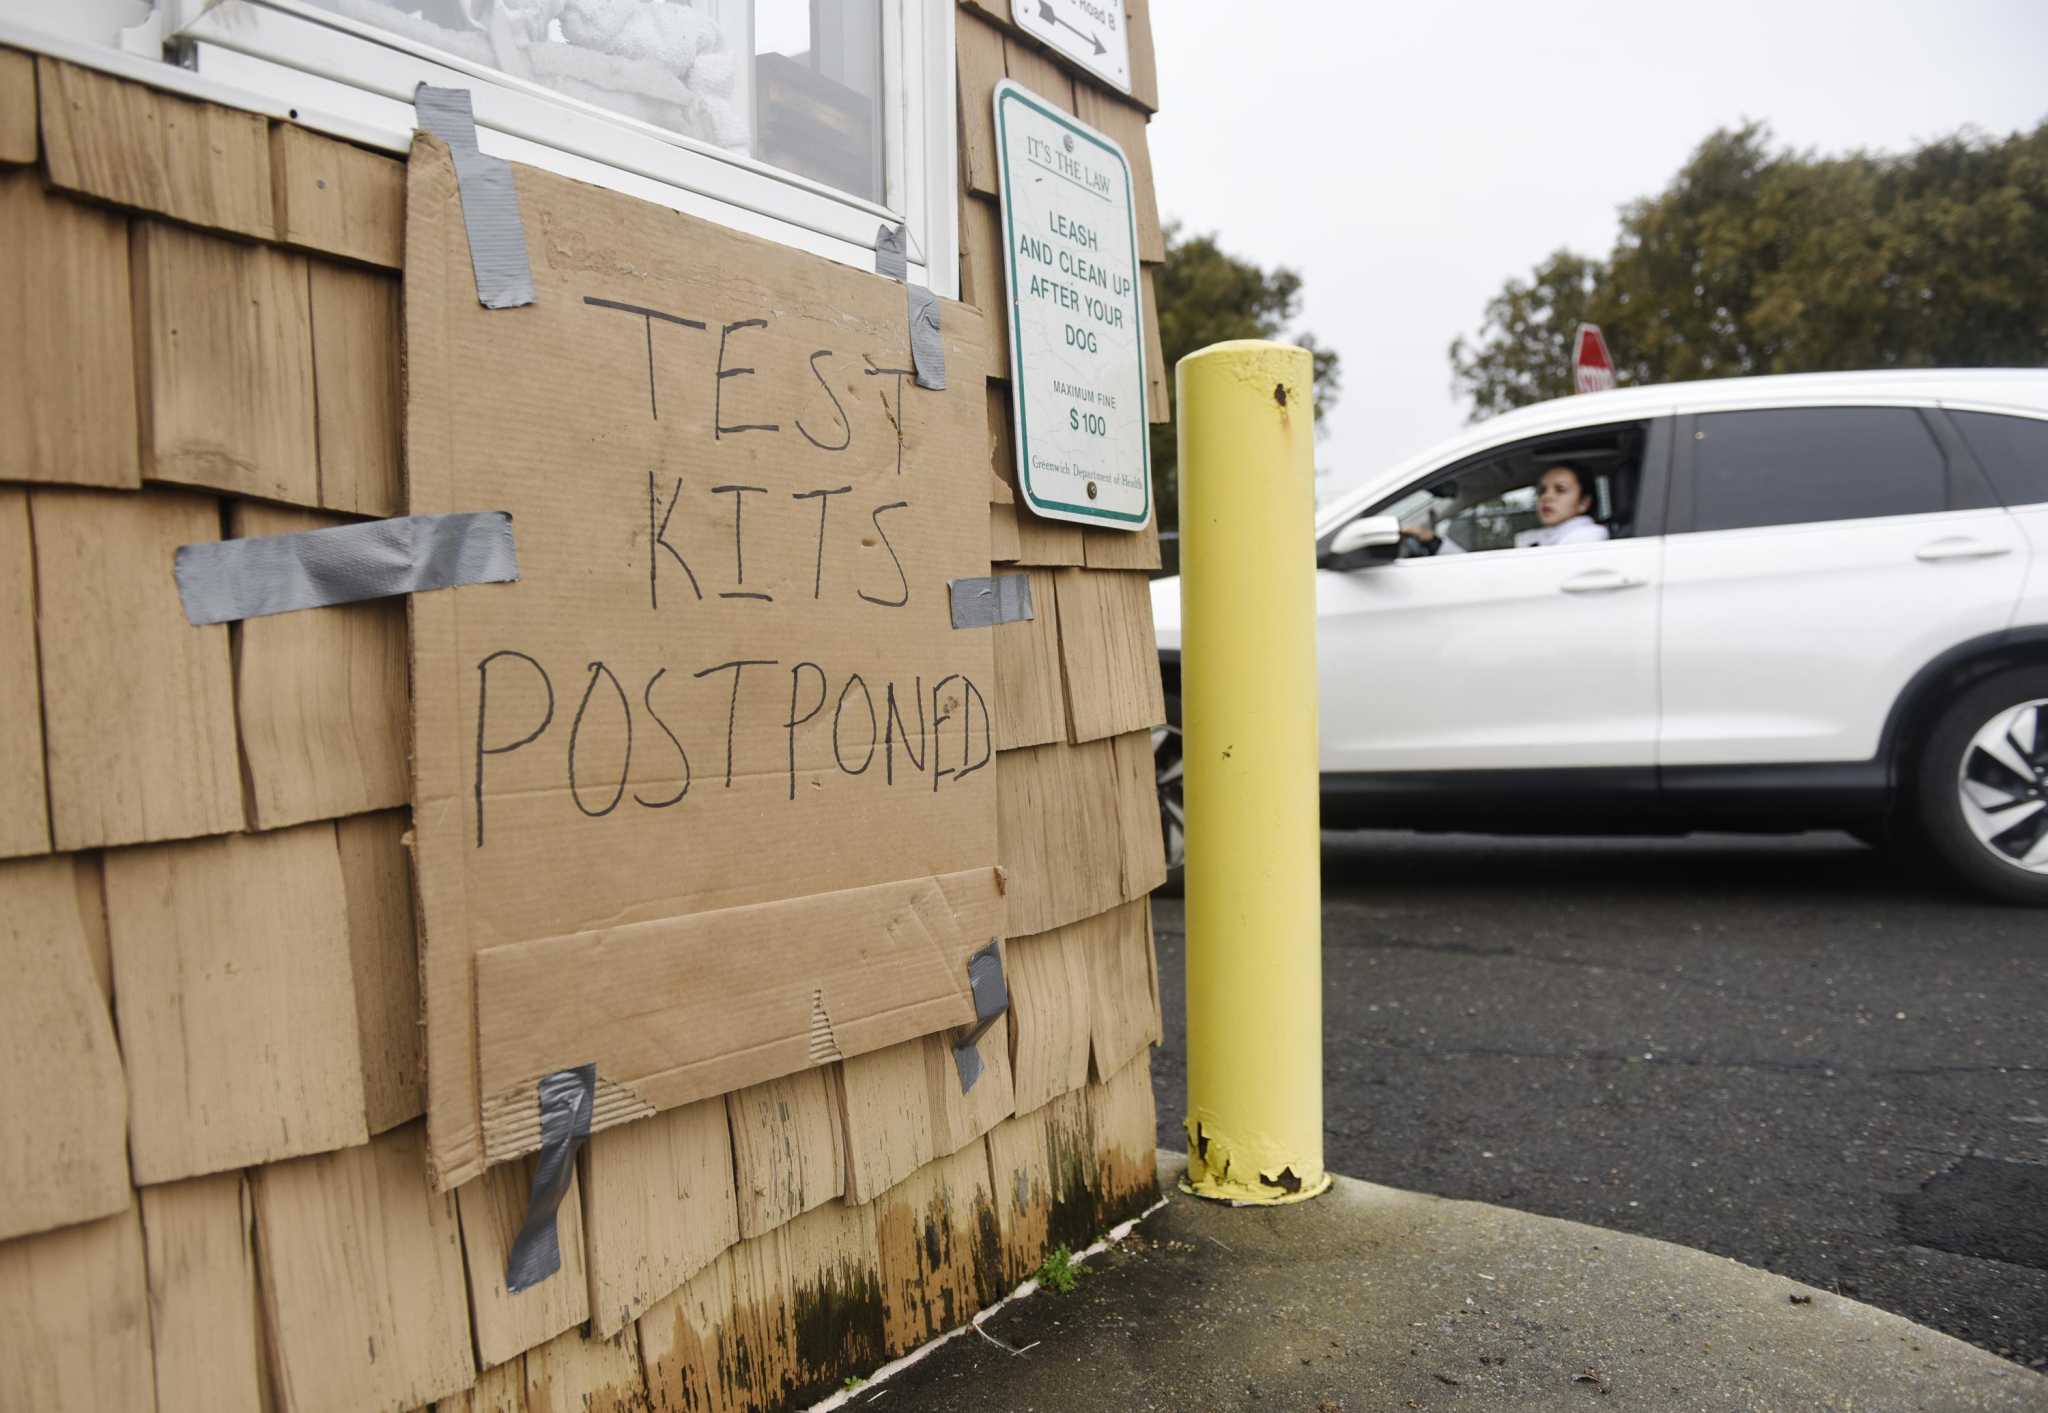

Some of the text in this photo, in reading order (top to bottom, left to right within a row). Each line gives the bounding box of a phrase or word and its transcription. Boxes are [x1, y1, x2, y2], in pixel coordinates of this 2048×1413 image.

[1026, 135, 1111, 195] IT'S THE LAW
[1049, 210, 1098, 251] LEASH
[1020, 234, 1130, 298] AND CLEAN UP
[1030, 274, 1123, 329] AFTER YOUR
[1065, 324, 1098, 354] DOG
[583, 295, 919, 476] TEST
[1053, 380, 1116, 409] MAXIMUM FINE
[1070, 408, 1106, 437] $100
[1032, 455, 1143, 490] Greenwich Department of Health
[648, 470, 909, 611] KITS
[475, 649, 991, 849] POSTPONED
